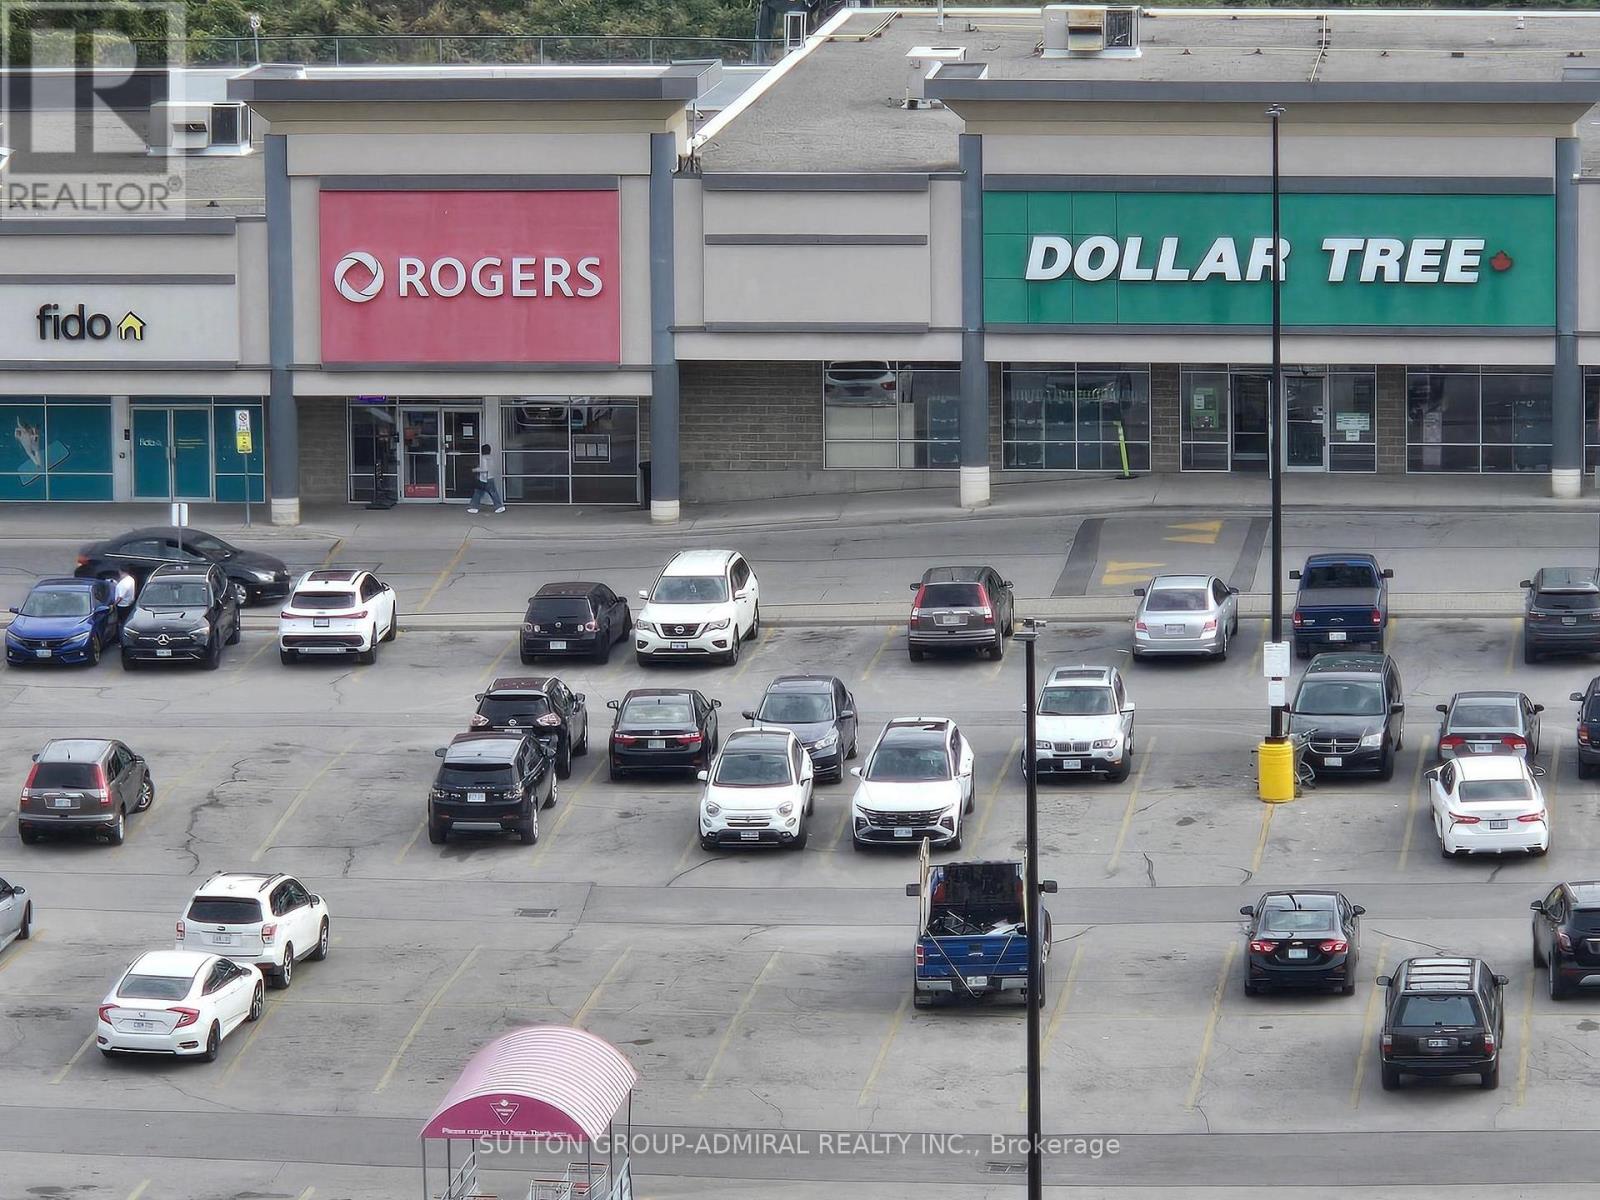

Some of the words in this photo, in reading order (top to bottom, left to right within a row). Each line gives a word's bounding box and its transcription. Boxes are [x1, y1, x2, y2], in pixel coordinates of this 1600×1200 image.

[399, 256, 603, 298] ROGERS
[1025, 236, 1291, 283] DOLLAR
[1321, 237, 1485, 283] TREE
[36, 303, 112, 340] fido
